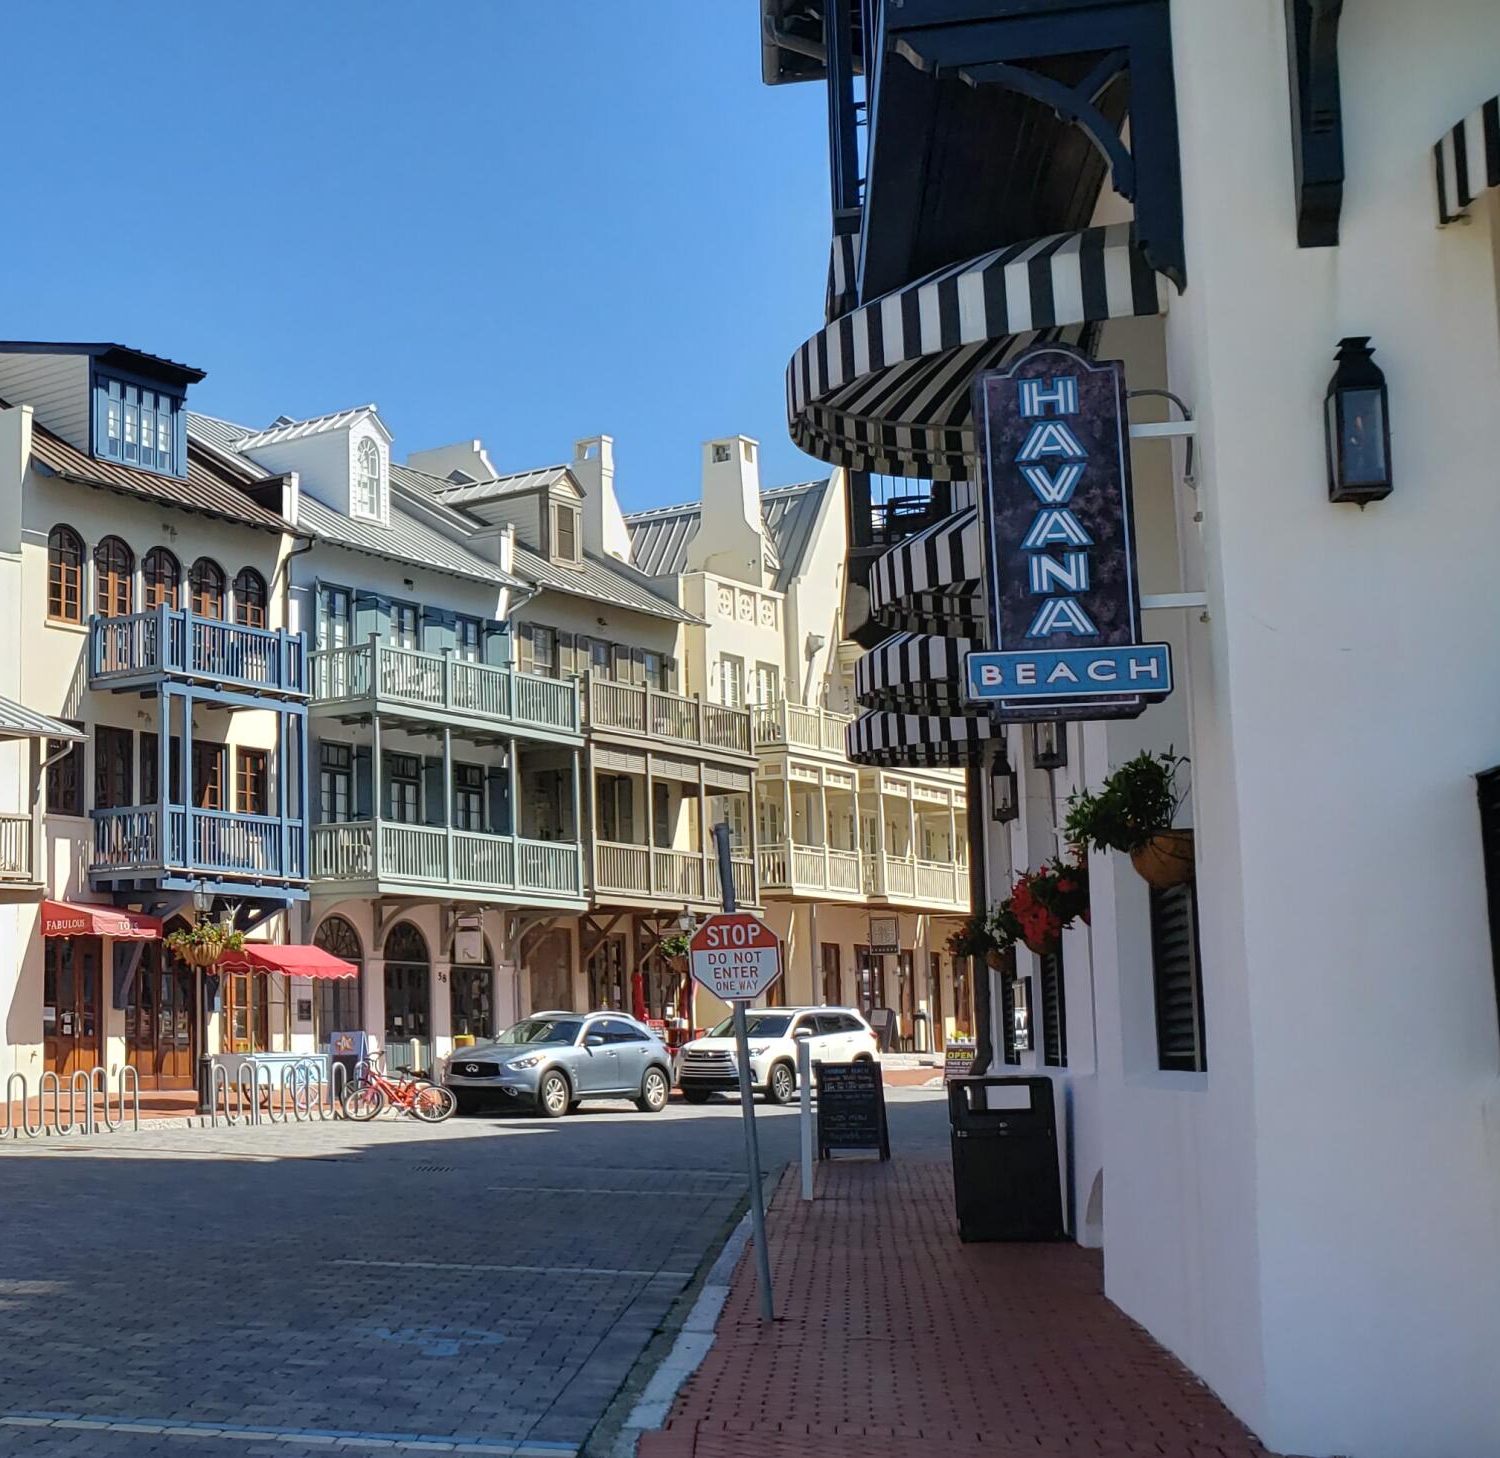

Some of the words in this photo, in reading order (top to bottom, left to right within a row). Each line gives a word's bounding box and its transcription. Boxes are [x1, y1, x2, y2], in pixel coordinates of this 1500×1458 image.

[1014, 376, 1099, 638] HAVANA
[980, 657, 1158, 686] BEACH
[46, 919, 84, 930] FABULOUS
[707, 924, 760, 946] STOP
[708, 953, 727, 964] DO
[734, 951, 761, 963] NOT
[713, 966, 759, 979] ENTER
[716, 980, 736, 991] ONE
[738, 980, 758, 990] WAY
[947, 1051, 975, 1059] OPEN
